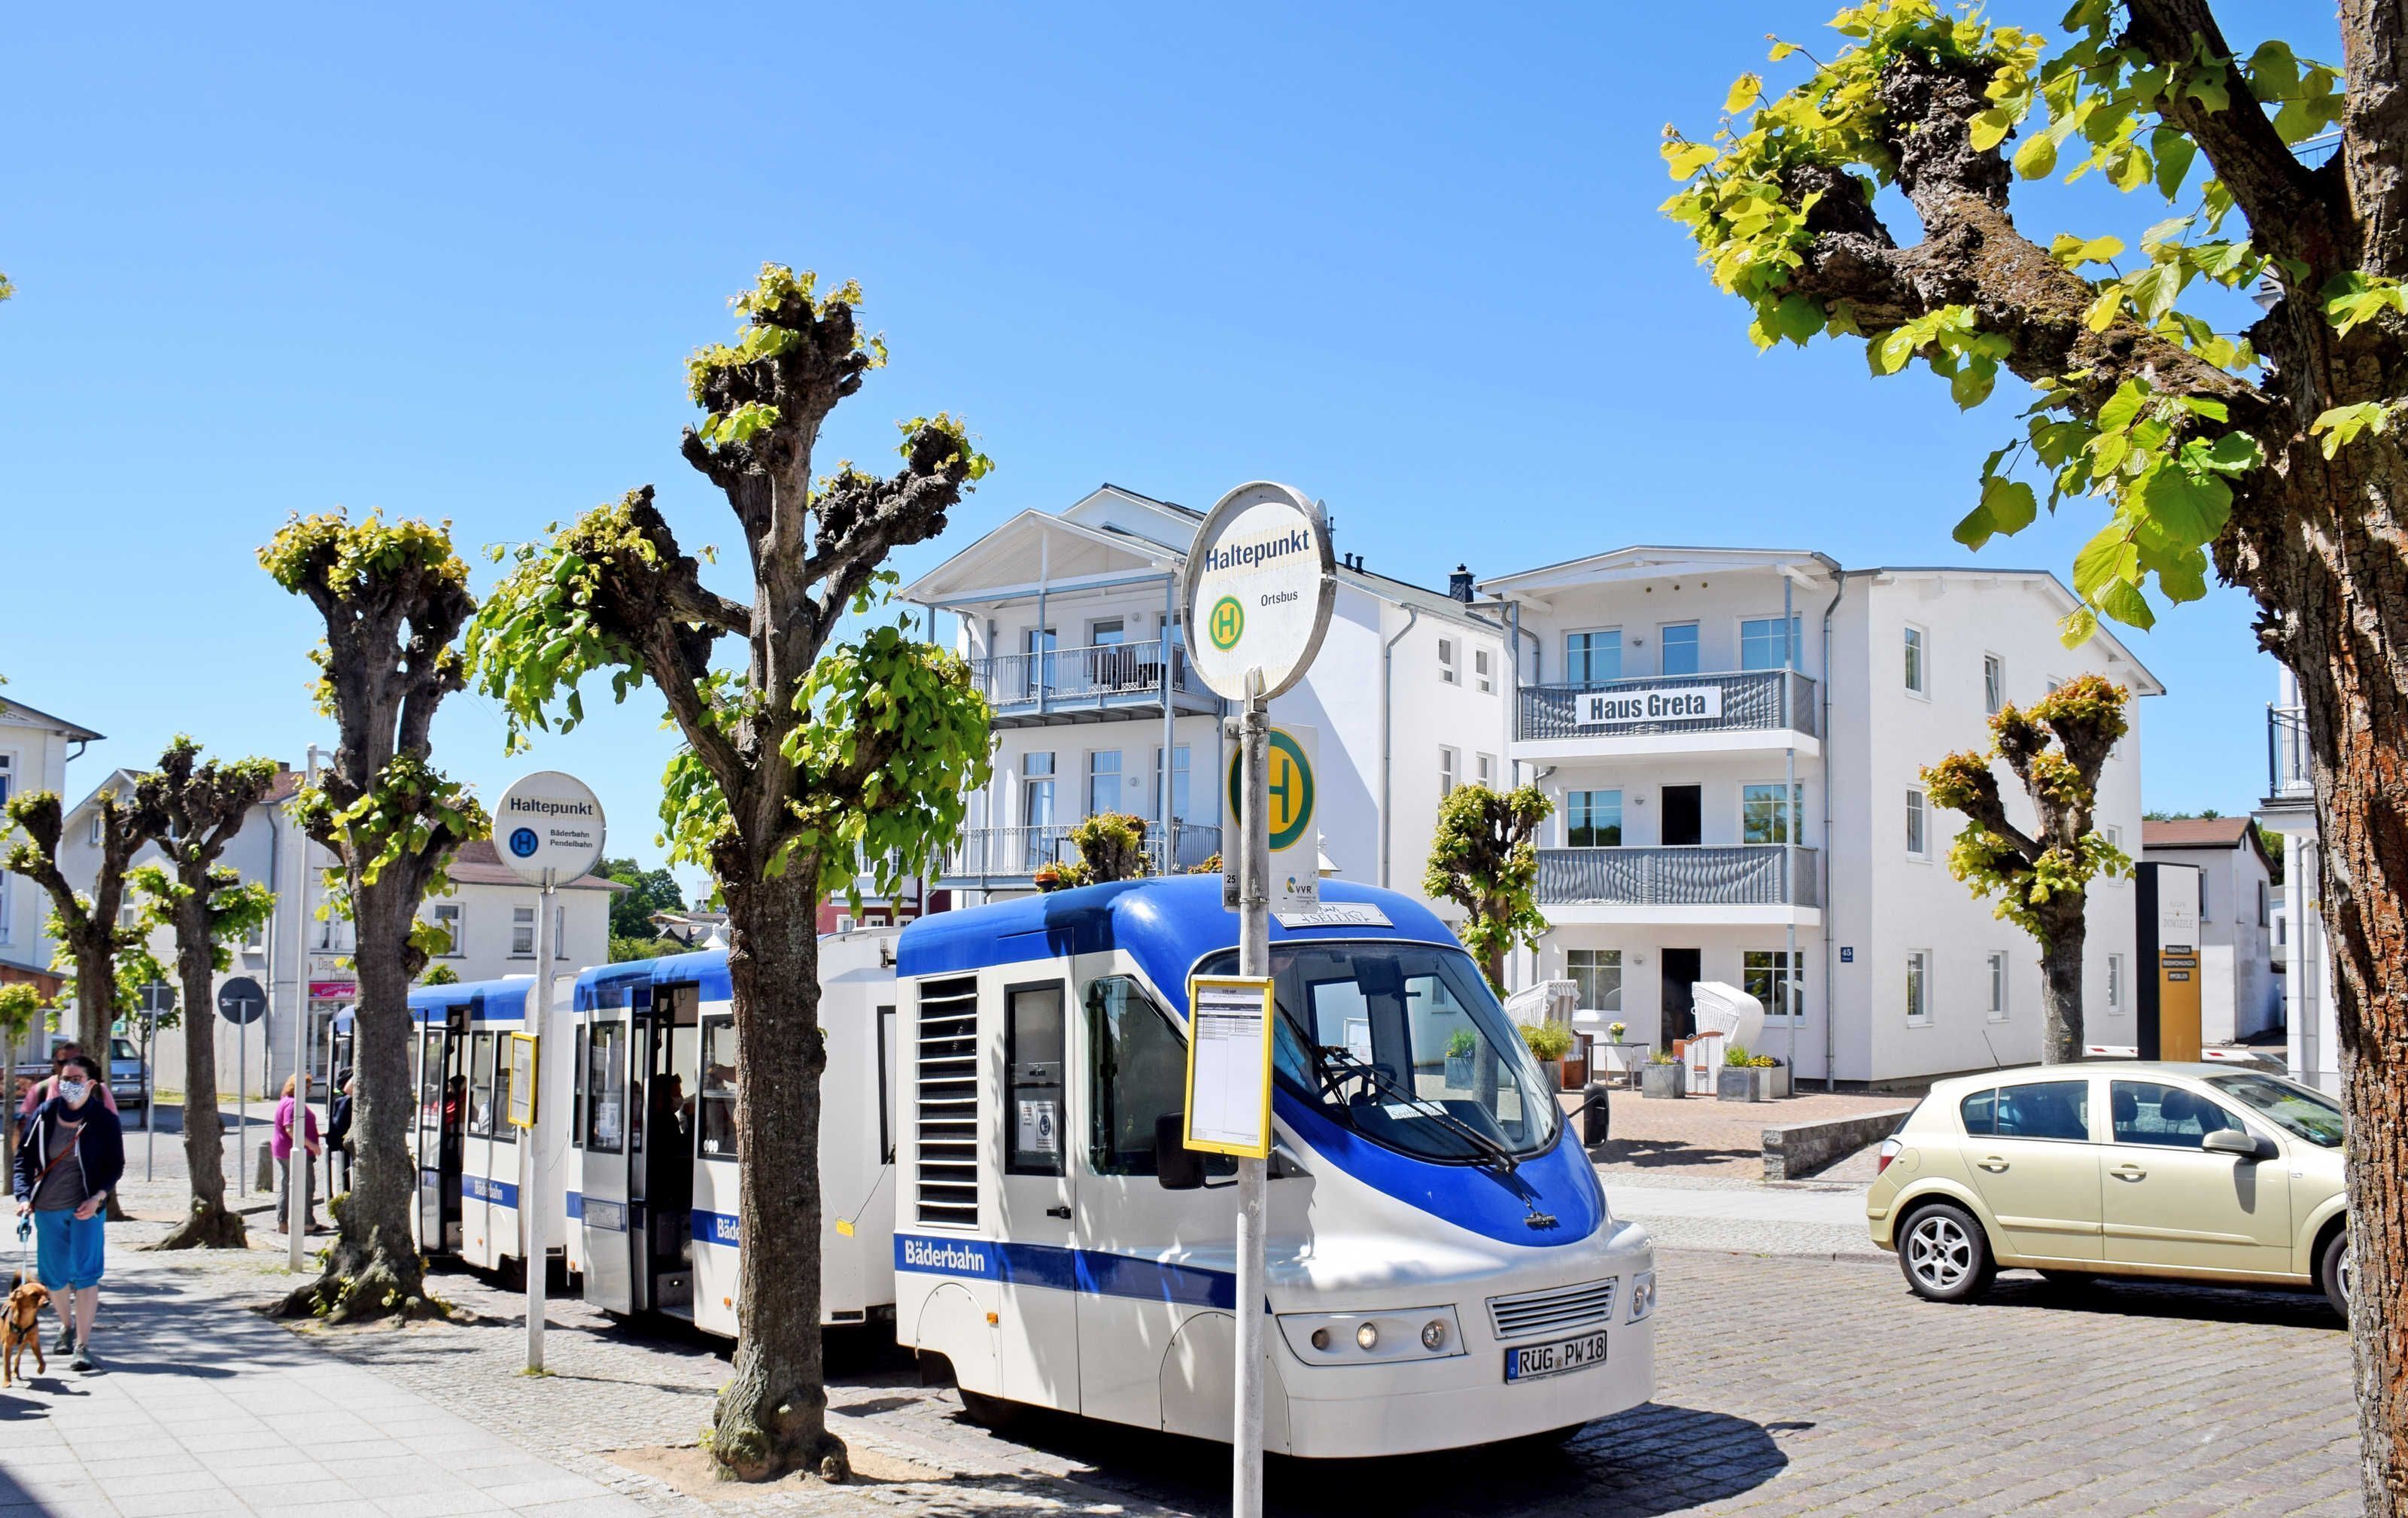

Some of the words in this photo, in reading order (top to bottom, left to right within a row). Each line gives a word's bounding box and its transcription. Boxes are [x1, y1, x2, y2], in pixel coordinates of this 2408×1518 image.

[1206, 530, 1309, 572] Haltepunkt
[1260, 589, 1298, 607] Ortsbus
[1218, 606, 1235, 640] H
[1590, 698, 1642, 719] Haus
[1647, 693, 1706, 717] Greta
[510, 798, 593, 816] Haltepunkt
[517, 835, 531, 850] H
[550, 829, 589, 838] Bäderbahn
[550, 840, 593, 848] Pendelbahn
[1227, 875, 1236, 884] 25
[1295, 884, 1312, 894] VVR
[905, 1240, 985, 1272] Bäderbahn
[1519, 1348, 1553, 1374] RÜG
[1564, 1341, 1584, 1365] PW
[1586, 1337, 1604, 1361] 18
